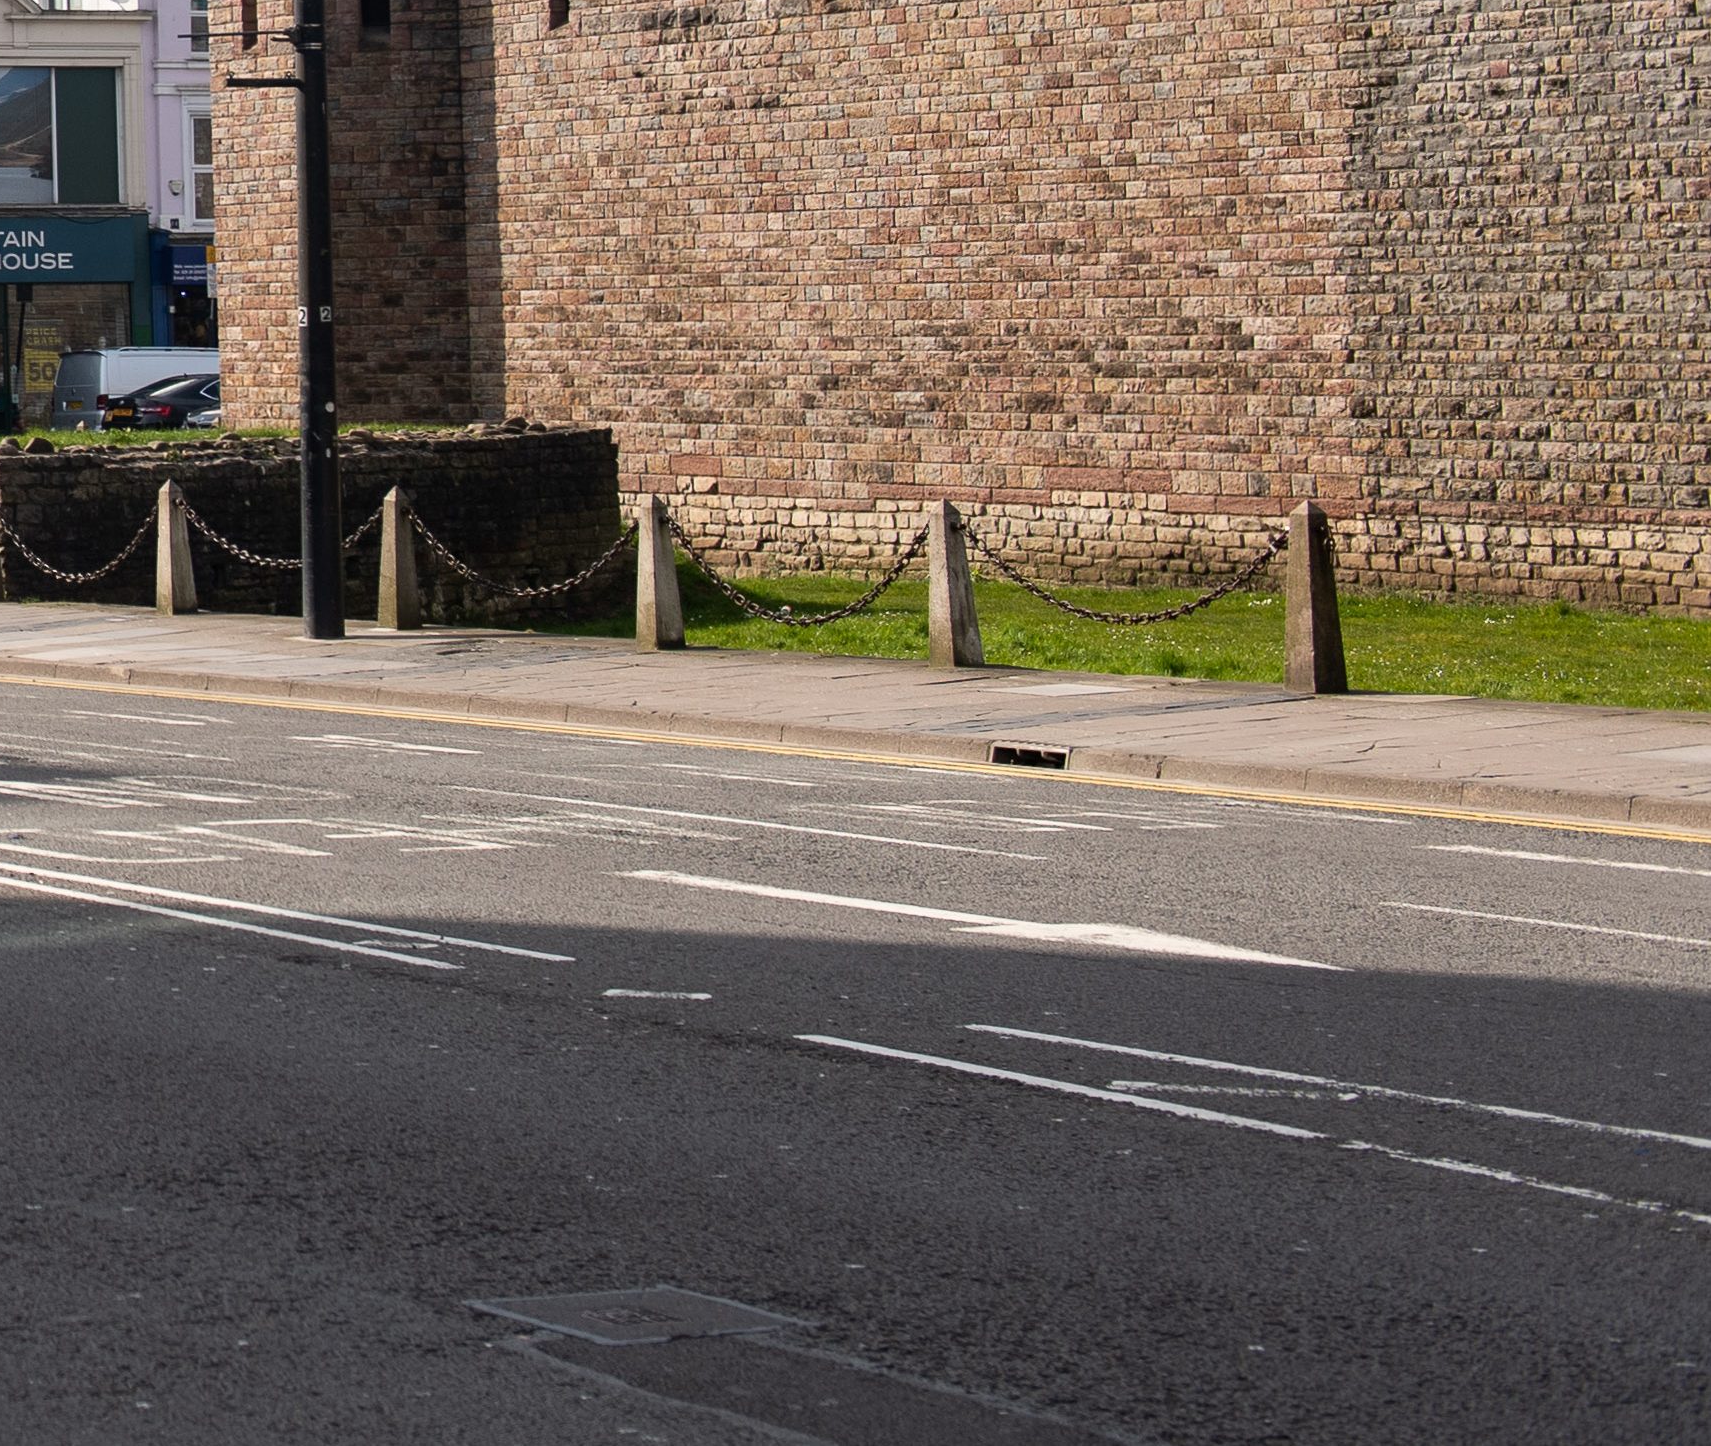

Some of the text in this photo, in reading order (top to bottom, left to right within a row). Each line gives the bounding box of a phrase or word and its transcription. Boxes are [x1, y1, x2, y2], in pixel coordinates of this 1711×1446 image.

[299, 308, 306, 325] 2
[321, 307, 331, 320] 2
[29, 361, 57, 382] 50
